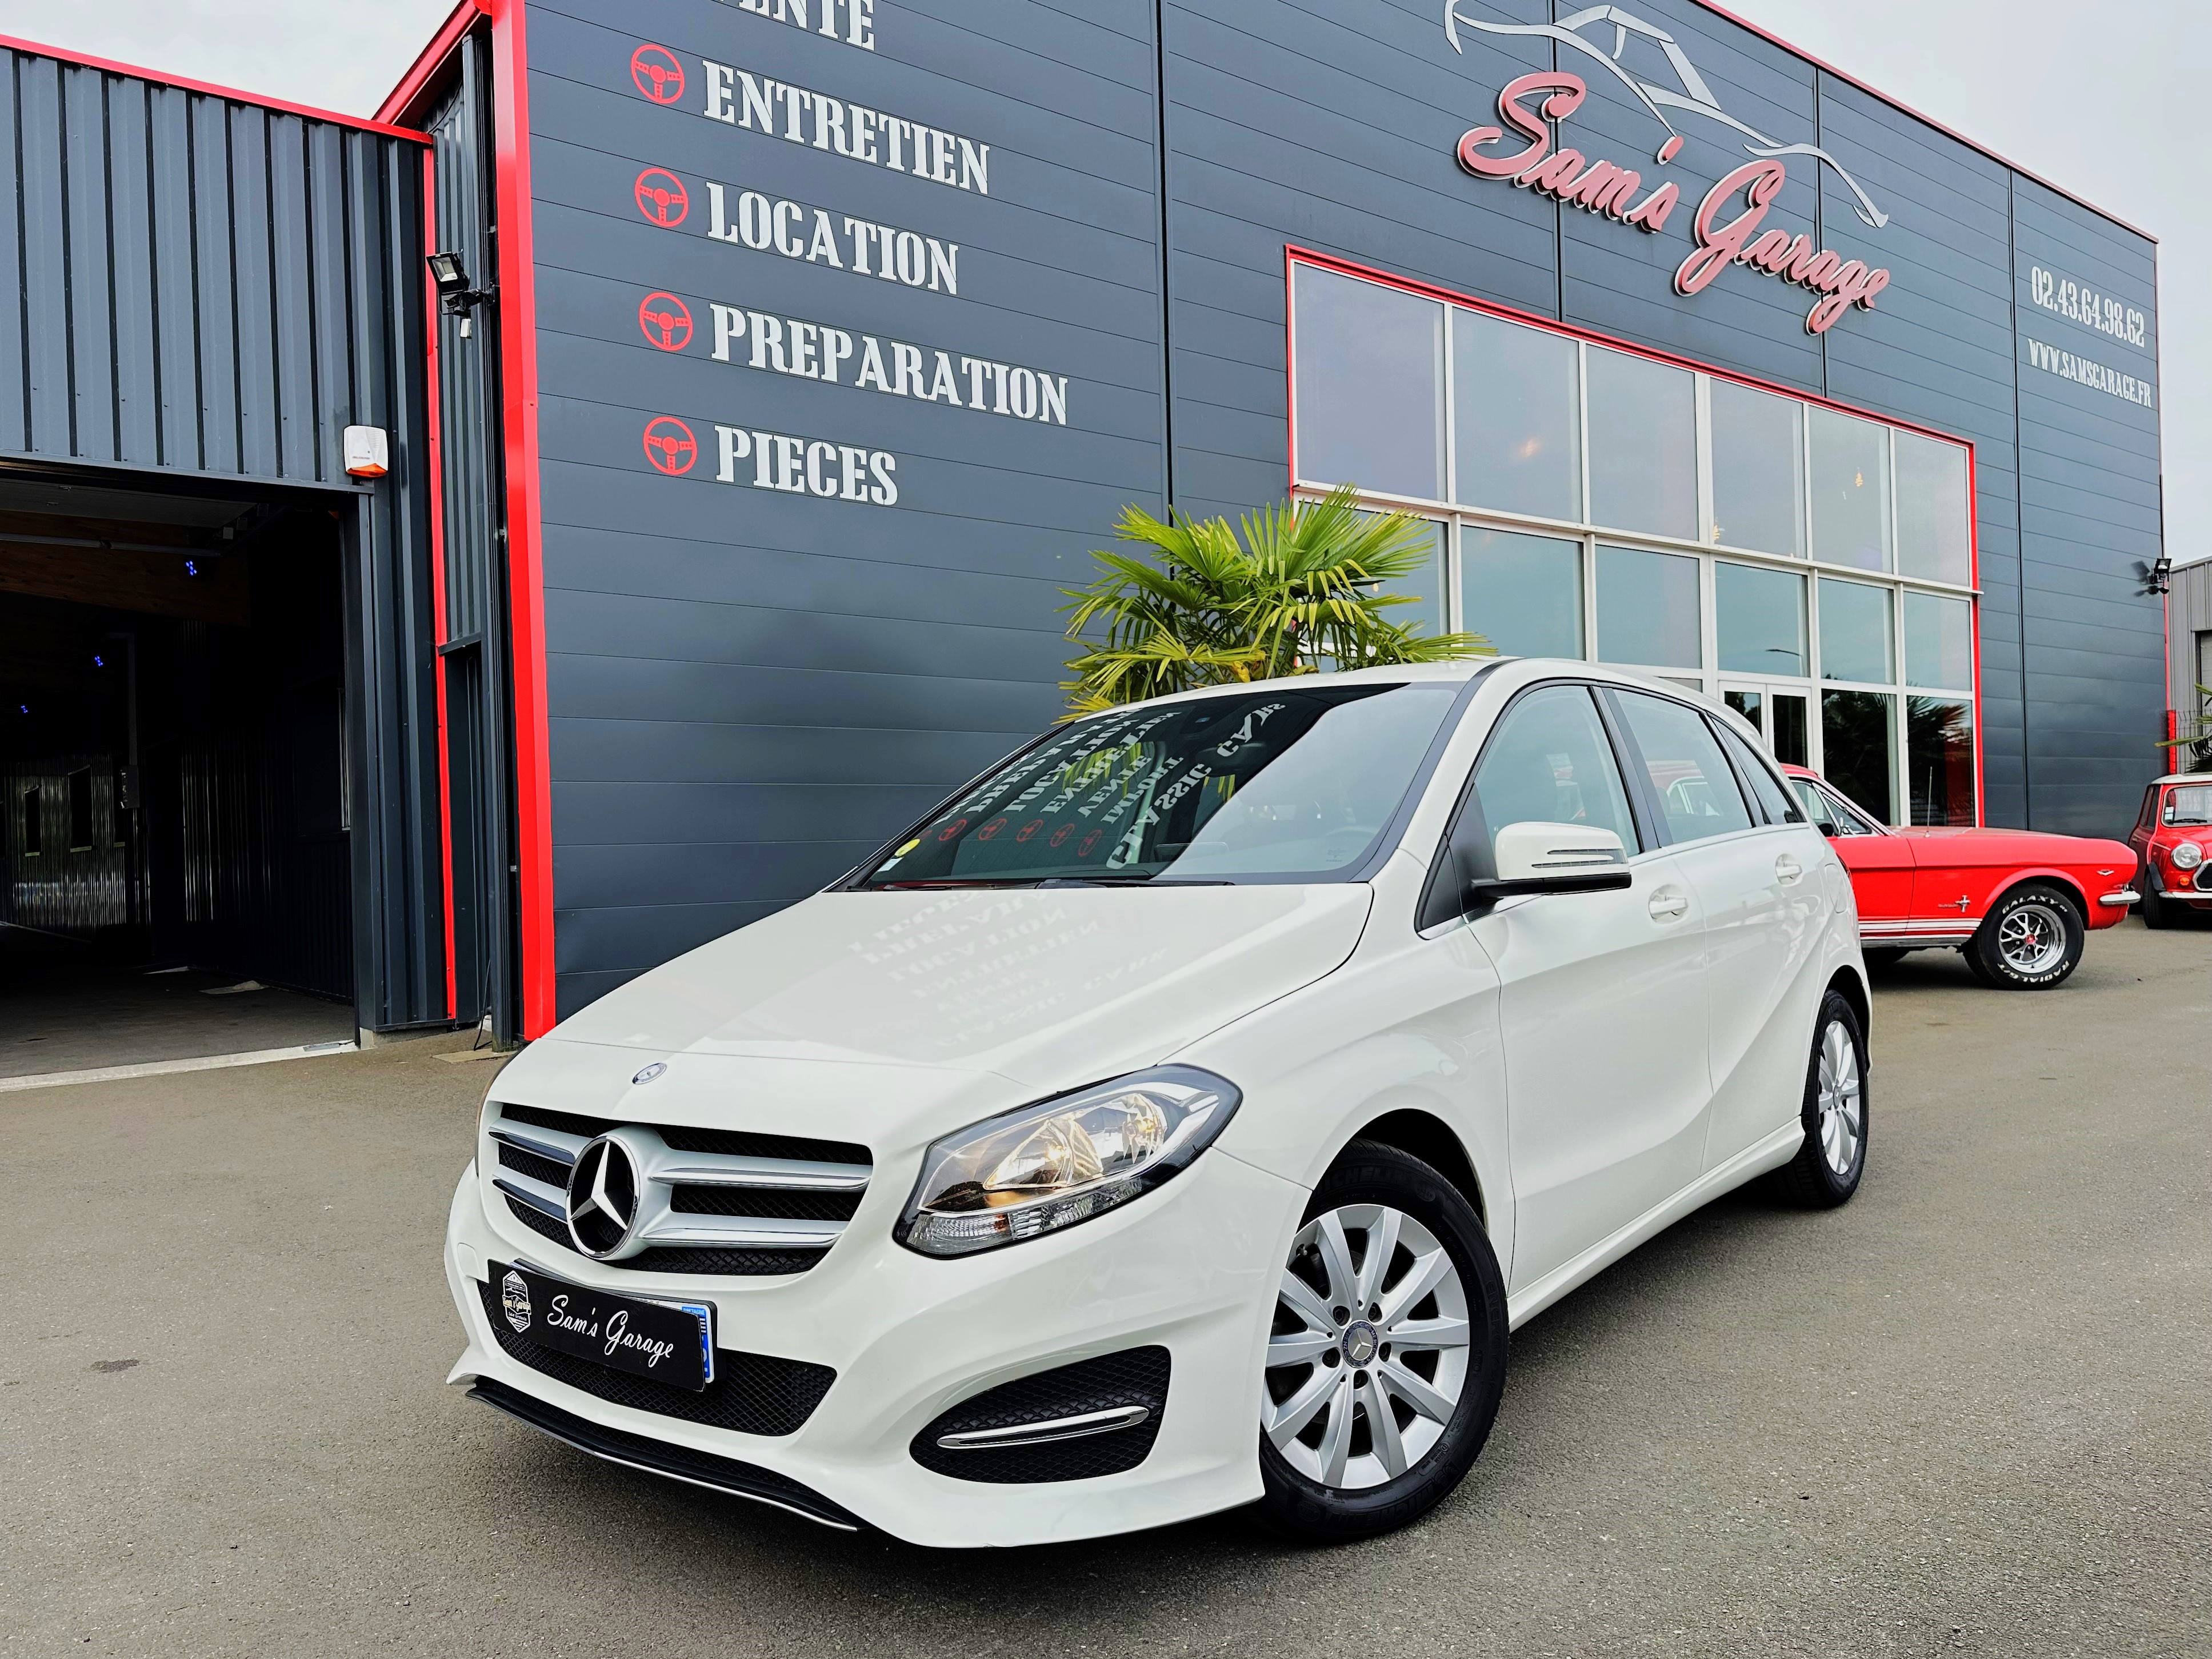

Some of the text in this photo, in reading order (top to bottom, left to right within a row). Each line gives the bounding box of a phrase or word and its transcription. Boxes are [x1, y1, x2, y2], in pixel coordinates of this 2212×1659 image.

[702, 59, 990, 195] ENTRETIEN
[706, 181, 958, 295] LOCATION
[1457, 71, 1890, 335] Sam's Garage
[2031, 266, 2145, 347] 02.43.64.98.62
[710, 303, 1068, 425] PREPARATION
[2028, 338, 2151, 407] WWW.SAMSGARAGE.FR
[714, 425, 898, 506] PIECES
[2002, 895, 2058, 914] GALAXY
[2021, 960, 2070, 982] RADIAL
[547, 1295, 674, 1368] Sam's Garage
